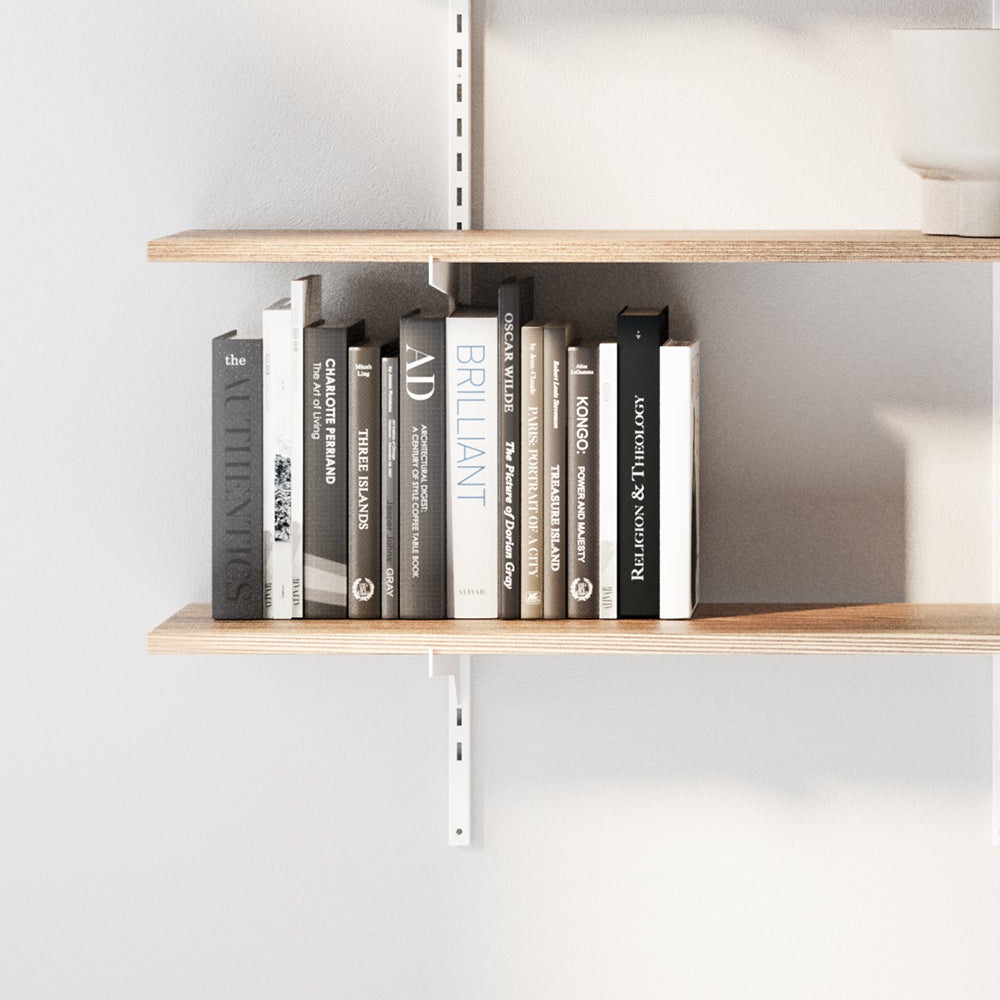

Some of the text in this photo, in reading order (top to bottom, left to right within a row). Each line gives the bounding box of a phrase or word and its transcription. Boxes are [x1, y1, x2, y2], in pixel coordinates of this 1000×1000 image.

[224, 354, 247, 366] the
[311, 362, 322, 440] The Art of Living
[405, 344, 435, 401] AD
[504, 312, 514, 413] OSCAR WILDE
[325, 358, 336, 485] CHARLOTTE PERRIAND
[411, 434, 419, 468] CENTURY
[456, 345, 486, 506] BRILLIANT
[576, 396, 588, 455] KONGO:
[224, 374, 251, 602] AUTHENTICS
[358, 429, 369, 531] THREE ISLANDS
[411, 469, 419, 480] OF
[411, 481, 419, 502] STYLE
[420, 424, 428, 513] ARCHITECTURAL DIGEST:
[528, 406, 539, 577] PARIS: PORTRAIT OF A CITY
[631, 395, 645, 581] RELIGION & THEOLOGY
[411, 502, 419, 532] COFFEE
[411, 533, 419, 554] TABLE
[503, 441, 515, 590] The Picture of Dorian Gray
[550, 465, 560, 572] TREASURE ISLAND
[577, 466, 586, 563] POWER AND MAJESTY
[386, 568, 395, 598] GRAY
[411, 555, 419, 578] BOOK
